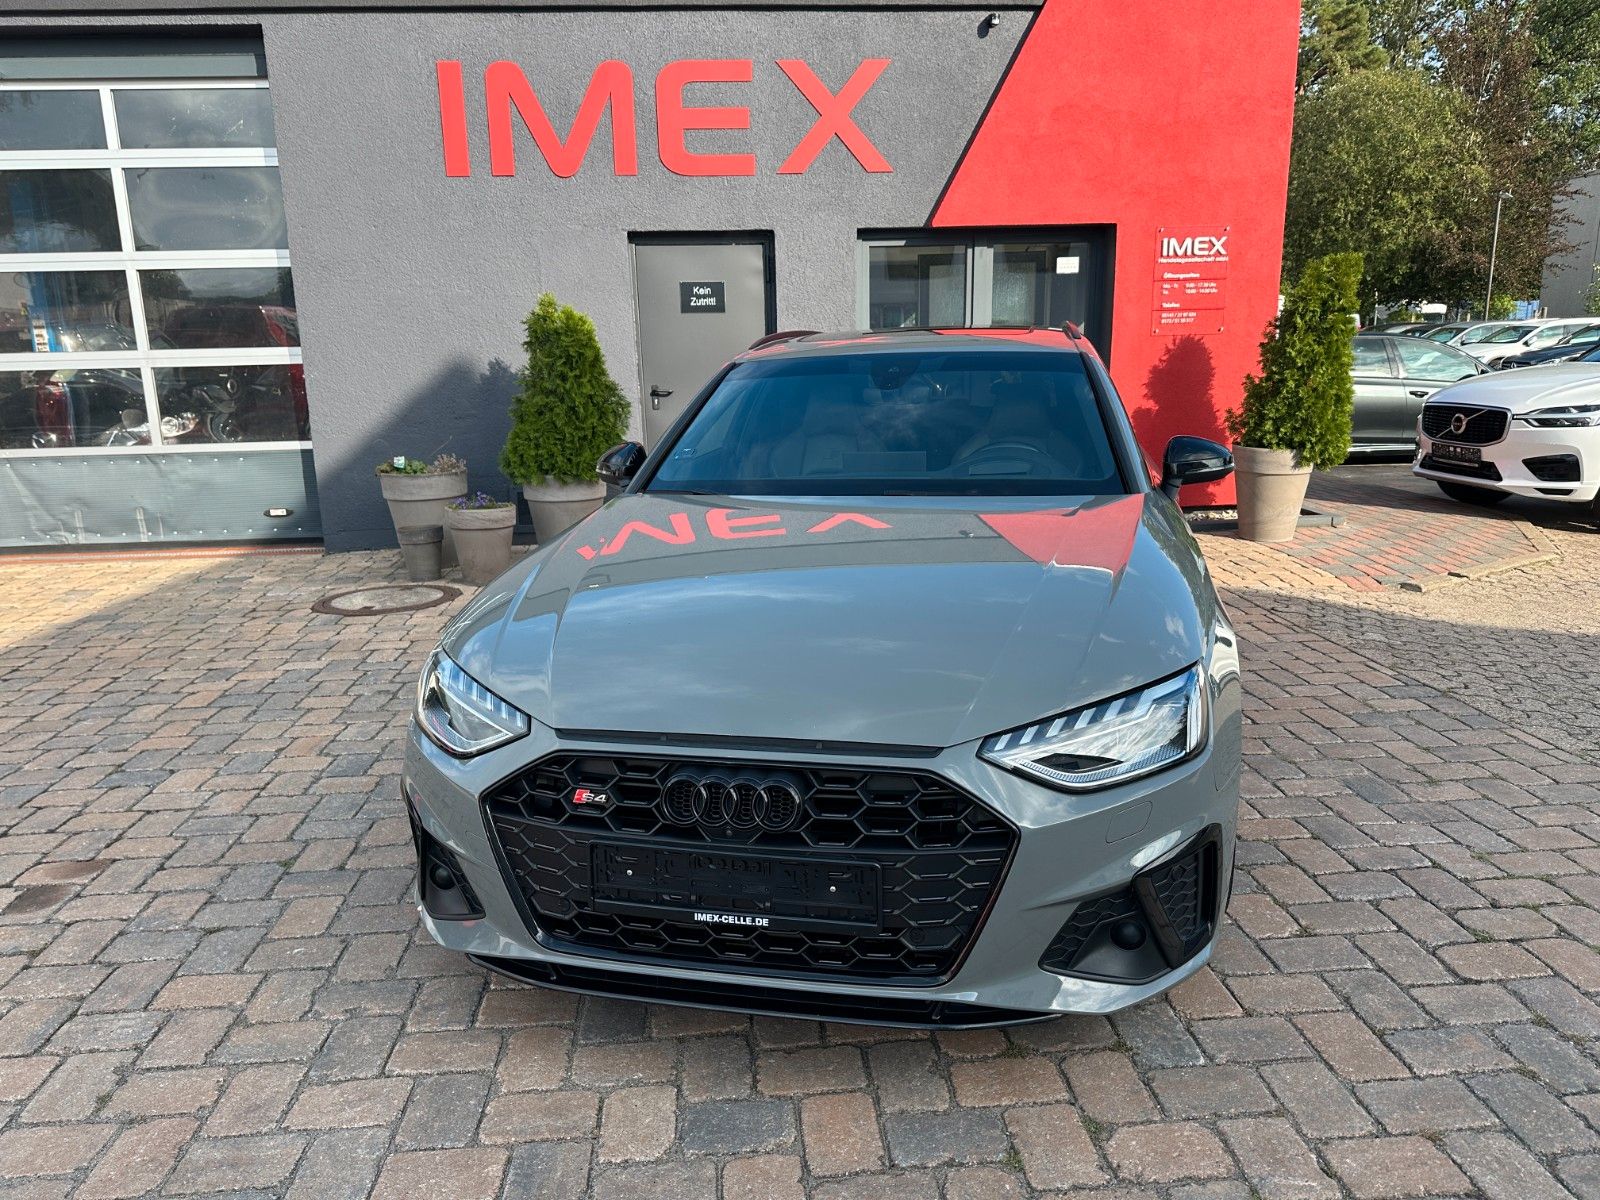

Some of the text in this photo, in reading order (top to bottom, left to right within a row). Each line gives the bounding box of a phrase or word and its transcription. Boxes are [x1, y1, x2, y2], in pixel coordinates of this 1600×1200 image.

[436, 58, 894, 178] IMEX
[1161, 235, 1228, 257] IMEX
[693, 286, 712, 295] Kein
[577, 790, 606, 804] S4
[694, 912, 769, 927] IMEX-CELLE.DE
